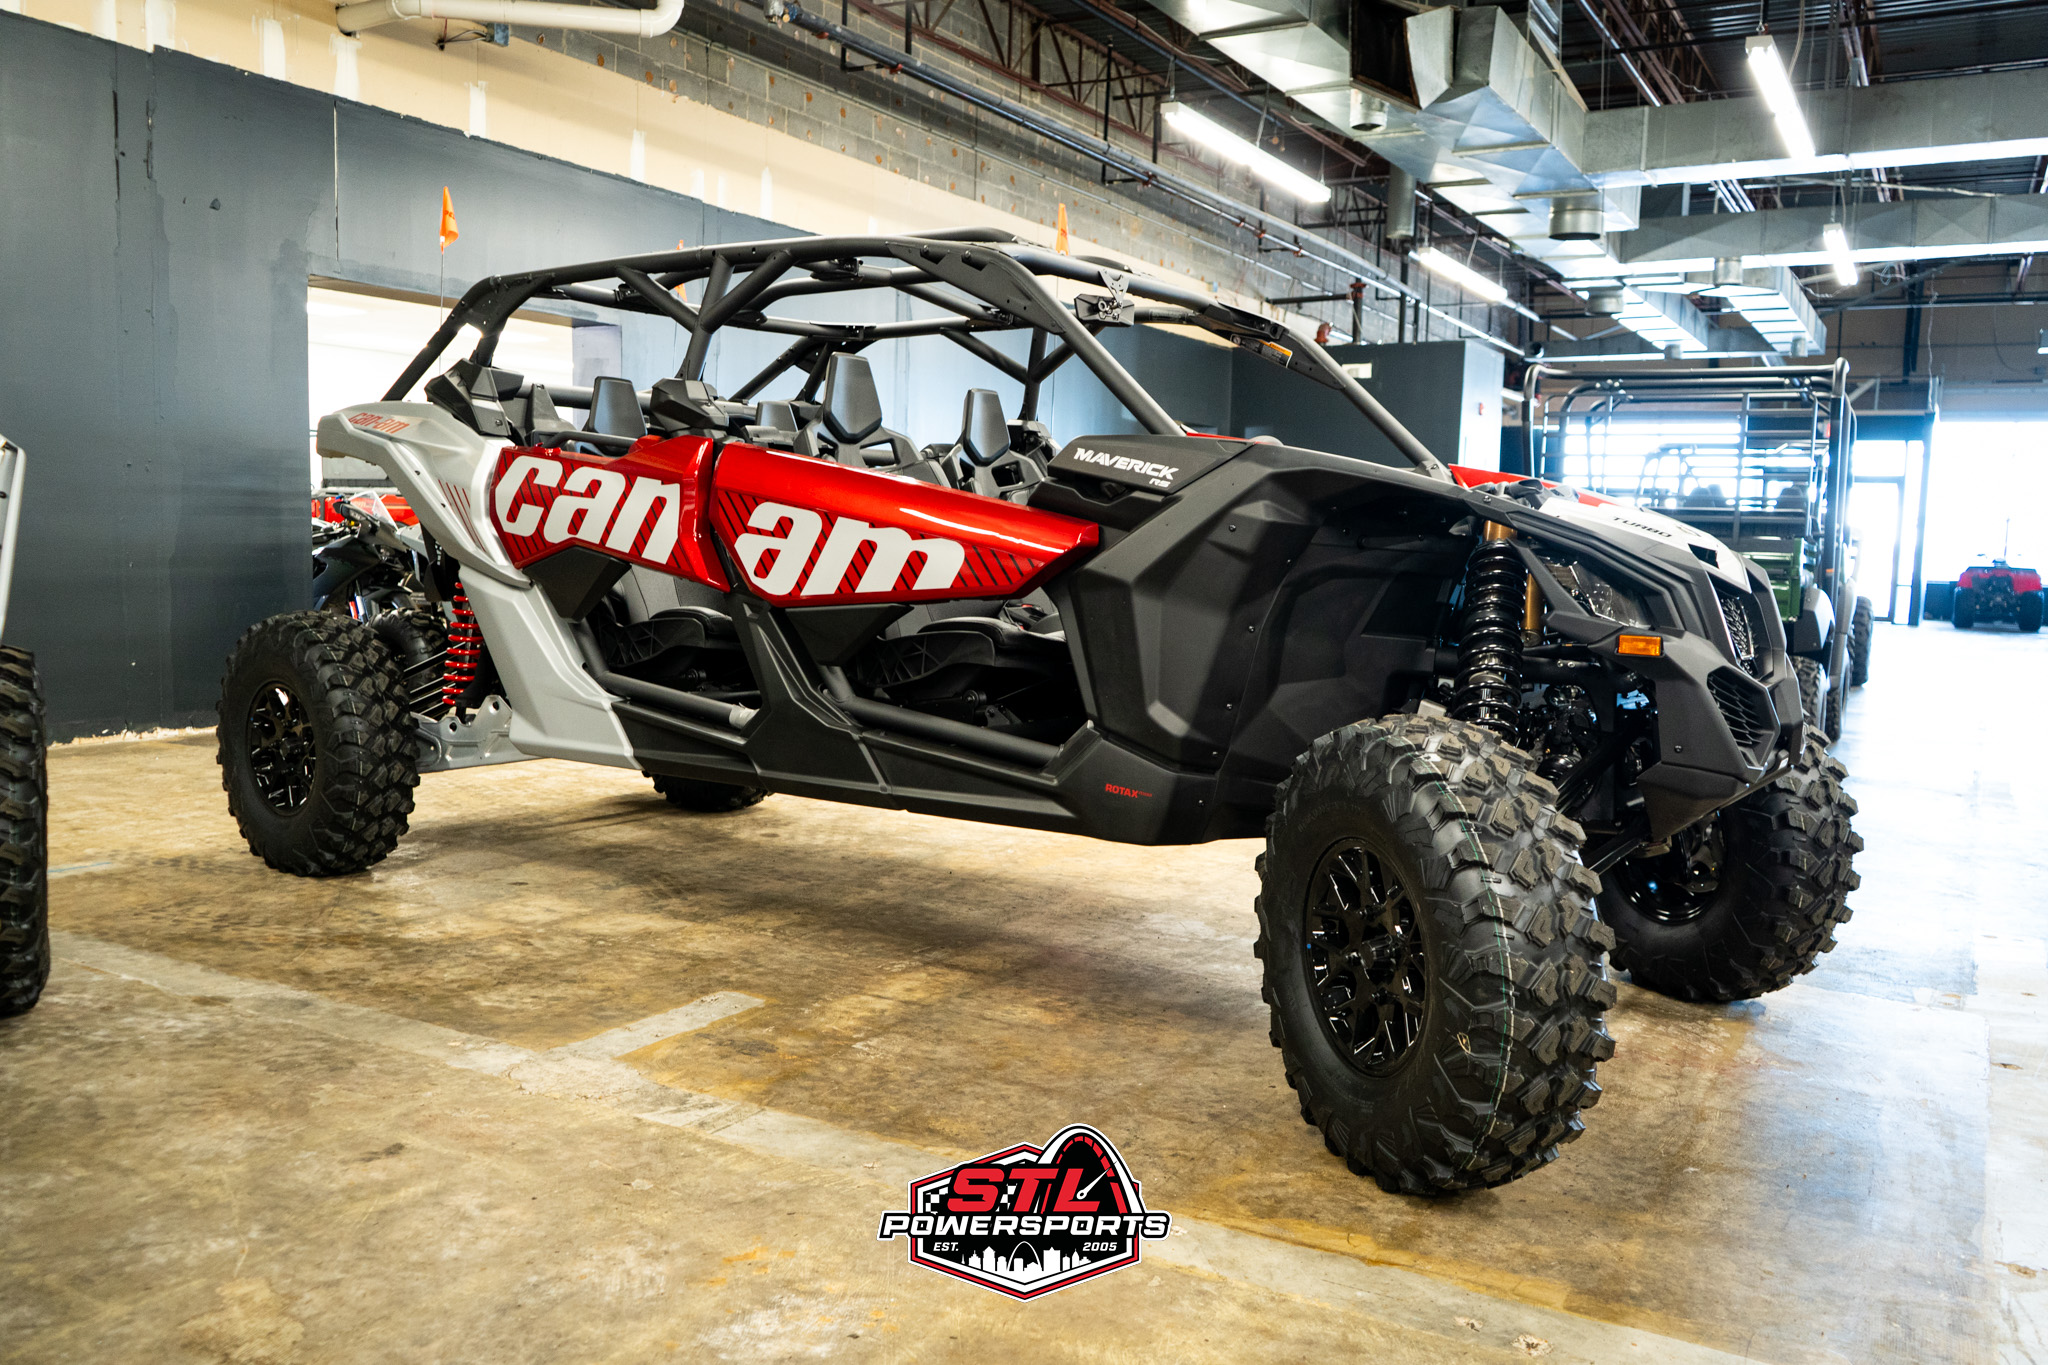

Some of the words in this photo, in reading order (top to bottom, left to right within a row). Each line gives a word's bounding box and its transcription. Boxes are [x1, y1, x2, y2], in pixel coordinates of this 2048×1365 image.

[1073, 447, 1179, 480] MAVERICK
[1149, 478, 1171, 488] RS
[495, 455, 681, 565] can
[734, 501, 965, 596] am
[1613, 517, 1672, 537] TURBO
[1105, 783, 1138, 798] ROTAX
